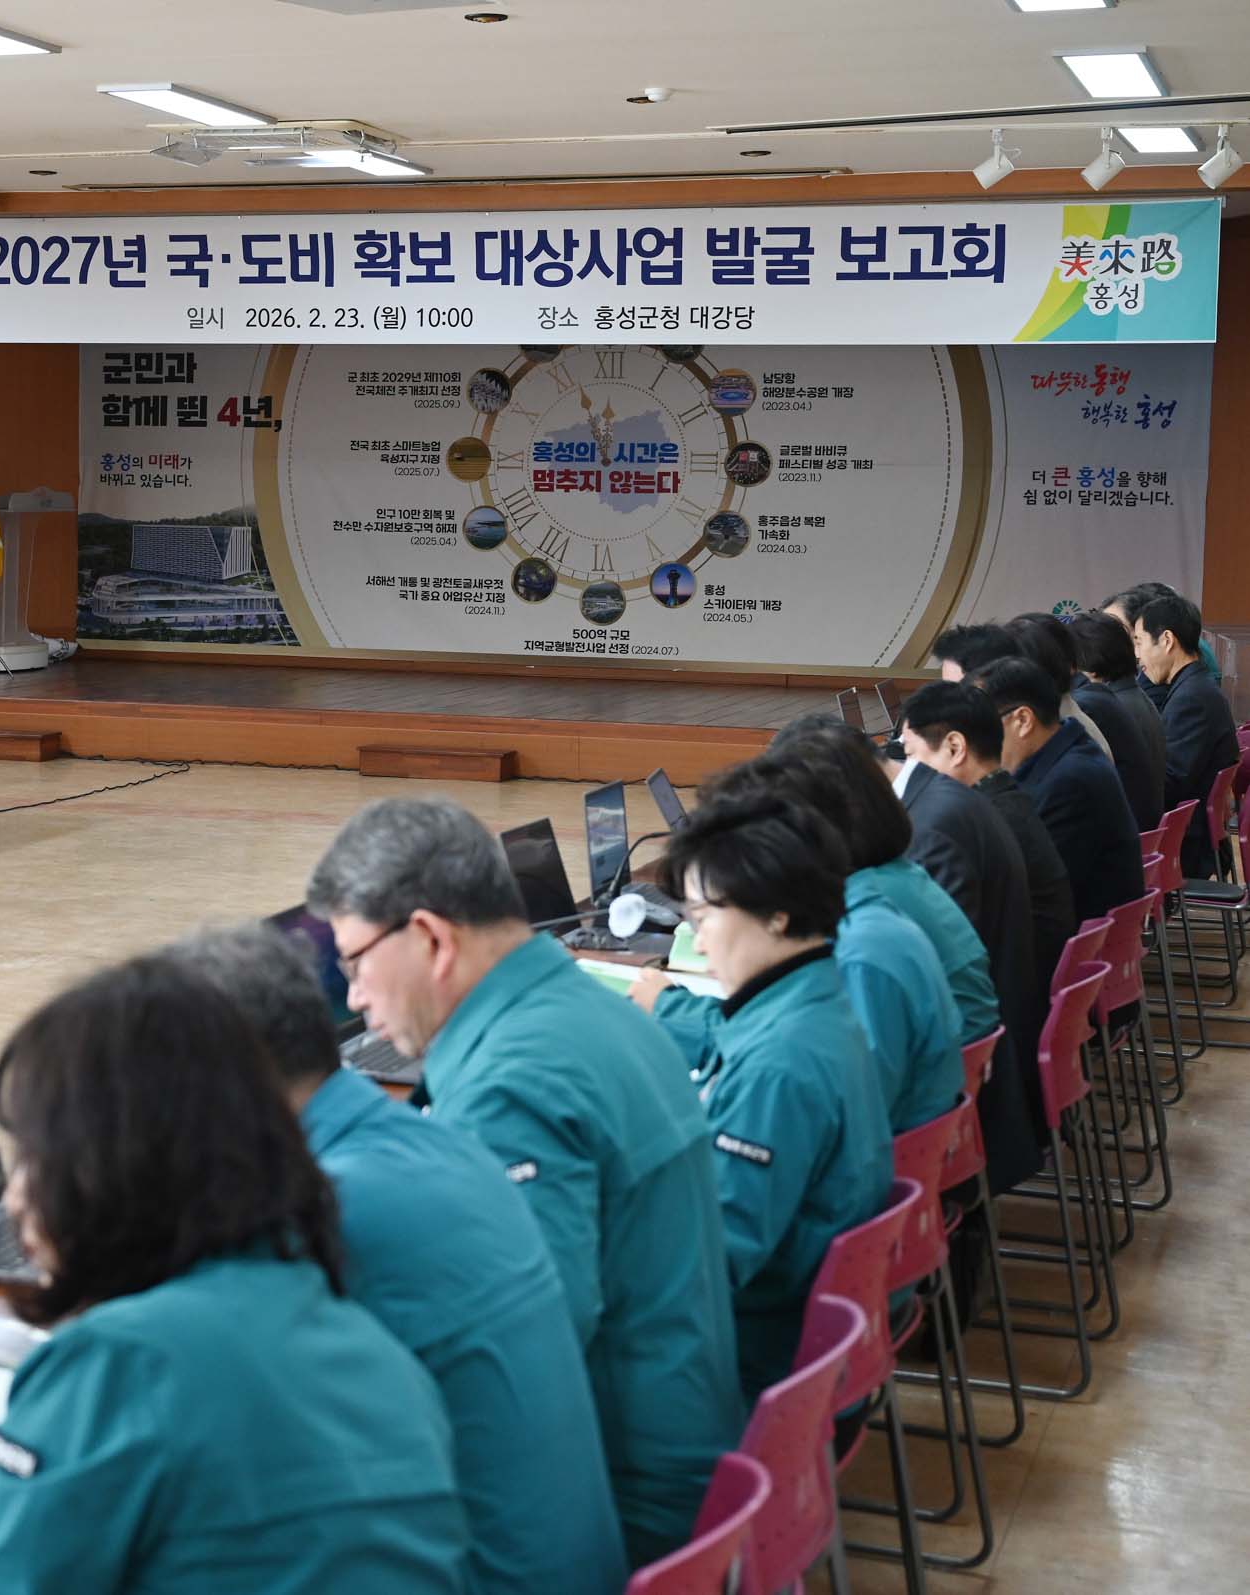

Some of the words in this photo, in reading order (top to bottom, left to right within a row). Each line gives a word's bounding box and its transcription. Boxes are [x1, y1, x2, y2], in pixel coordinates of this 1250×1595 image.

[166, 231, 335, 288] 국·도비
[352, 229, 456, 287] 확보
[474, 227, 684, 288] 대상사업
[706, 226, 815, 285] 발굴
[836, 222, 1006, 284] 보고회
[1089, 282, 1140, 310] 홍성
[187, 307, 225, 330] 일시
[245, 307, 302, 330] 2026.
[308, 307, 327, 330] 2.
[333, 307, 366, 330] 23.
[372, 304, 407, 331] (월)
[416, 307, 474, 330] 10:00
[536, 305, 580, 330] 장소
[593, 304, 681, 331] 홍성군청
[690, 304, 756, 331] 대강당
[102, 352, 198, 385] 군민과
[347, 372, 358, 383] 군
[358, 372, 380, 383] 최초
[381, 372, 423, 384] 2029년
[423, 372, 462, 384] 제110회
[763, 373, 796, 385] 남당항
[1030, 371, 1088, 397] 따뜻한
[1089, 363, 1132, 397] 동행
[355, 385, 396, 396] 전국체전
[398, 386, 439, 397] 주개최지
[440, 386, 462, 398] 선정
[762, 387, 829, 398] 해양분수공원
[831, 387, 855, 398] 개장
[414, 399, 461, 409] (2025.09.)
[762, 401, 812, 411] (2023.04.)
[101, 394, 169, 427] 함께
[176, 395, 208, 428] 뛴
[216, 395, 283, 433] 4년,
[1081, 399, 1129, 428] 행복한
[1134, 393, 1178, 430] 홍성
[350, 440, 370, 451] 전국
[371, 441, 391, 451] 최초
[392, 441, 441, 452] 스마트농업
[779, 445, 813, 457] 글로벌
[814, 445, 848, 457] 바비큐
[532, 441, 596, 463] 홍성의
[613, 442, 679, 464] 시간은
[101, 453, 143, 472] 홍성의
[148, 453, 193, 471] 미래가
[380, 454, 420, 464] 육성지구
[420, 454, 440, 465] 지정
[778, 459, 823, 470] 페스티벌
[825, 459, 848, 470] 성공
[850, 459, 873, 470] 개최
[394, 467, 441, 477] (2025.07.)
[778, 472, 822, 482] (2023.11.)
[1032, 469, 1046, 485] 더
[1051, 466, 1071, 487] 큰
[1076, 466, 1132, 489] 홍성을
[1136, 471, 1168, 488] 향해
[100, 473, 137, 488] 바뀌고
[140, 473, 193, 489] 있습니다.
[532, 469, 602, 493] 멈추지
[608, 471, 681, 494] 않는다
[1023, 489, 1038, 505] 쉼
[1043, 490, 1072, 506] 없이
[1077, 489, 1175, 507] 달리겠습니다.
[376, 508, 396, 519] 인구
[398, 509, 421, 520] 10만
[422, 509, 443, 520] 회복
[445, 509, 455, 520] 및
[333, 520, 362, 532] 천수만
[364, 522, 433, 533] 수자원보호구역
[435, 522, 457, 534] 해제
[757, 515, 801, 527] 홍주읍성
[803, 516, 826, 528] 복원
[757, 529, 790, 541] 가속화
[410, 536, 457, 547] (2025.04.)
[756, 543, 808, 554] (2024.03.)
[366, 576, 396, 587] 서해선
[398, 577, 419, 588] 개통
[420, 577, 430, 588] 및
[704, 584, 726, 596] 홍성
[399, 590, 419, 600] 국가
[420, 591, 440, 601] 중요
[442, 592, 483, 603] 어업유산
[485, 593, 506, 604] 지정
[703, 599, 757, 610] 스카이타워
[759, 600, 783, 611] 개장
[703, 613, 753, 623] (2024.05.)
[572, 628, 607, 640] 500억
[609, 630, 630, 640] 규모
[524, 640, 606, 653] 지역균형발전사업
[608, 643, 630, 654] 선정
[631, 645, 680, 656] (2024.07.)
